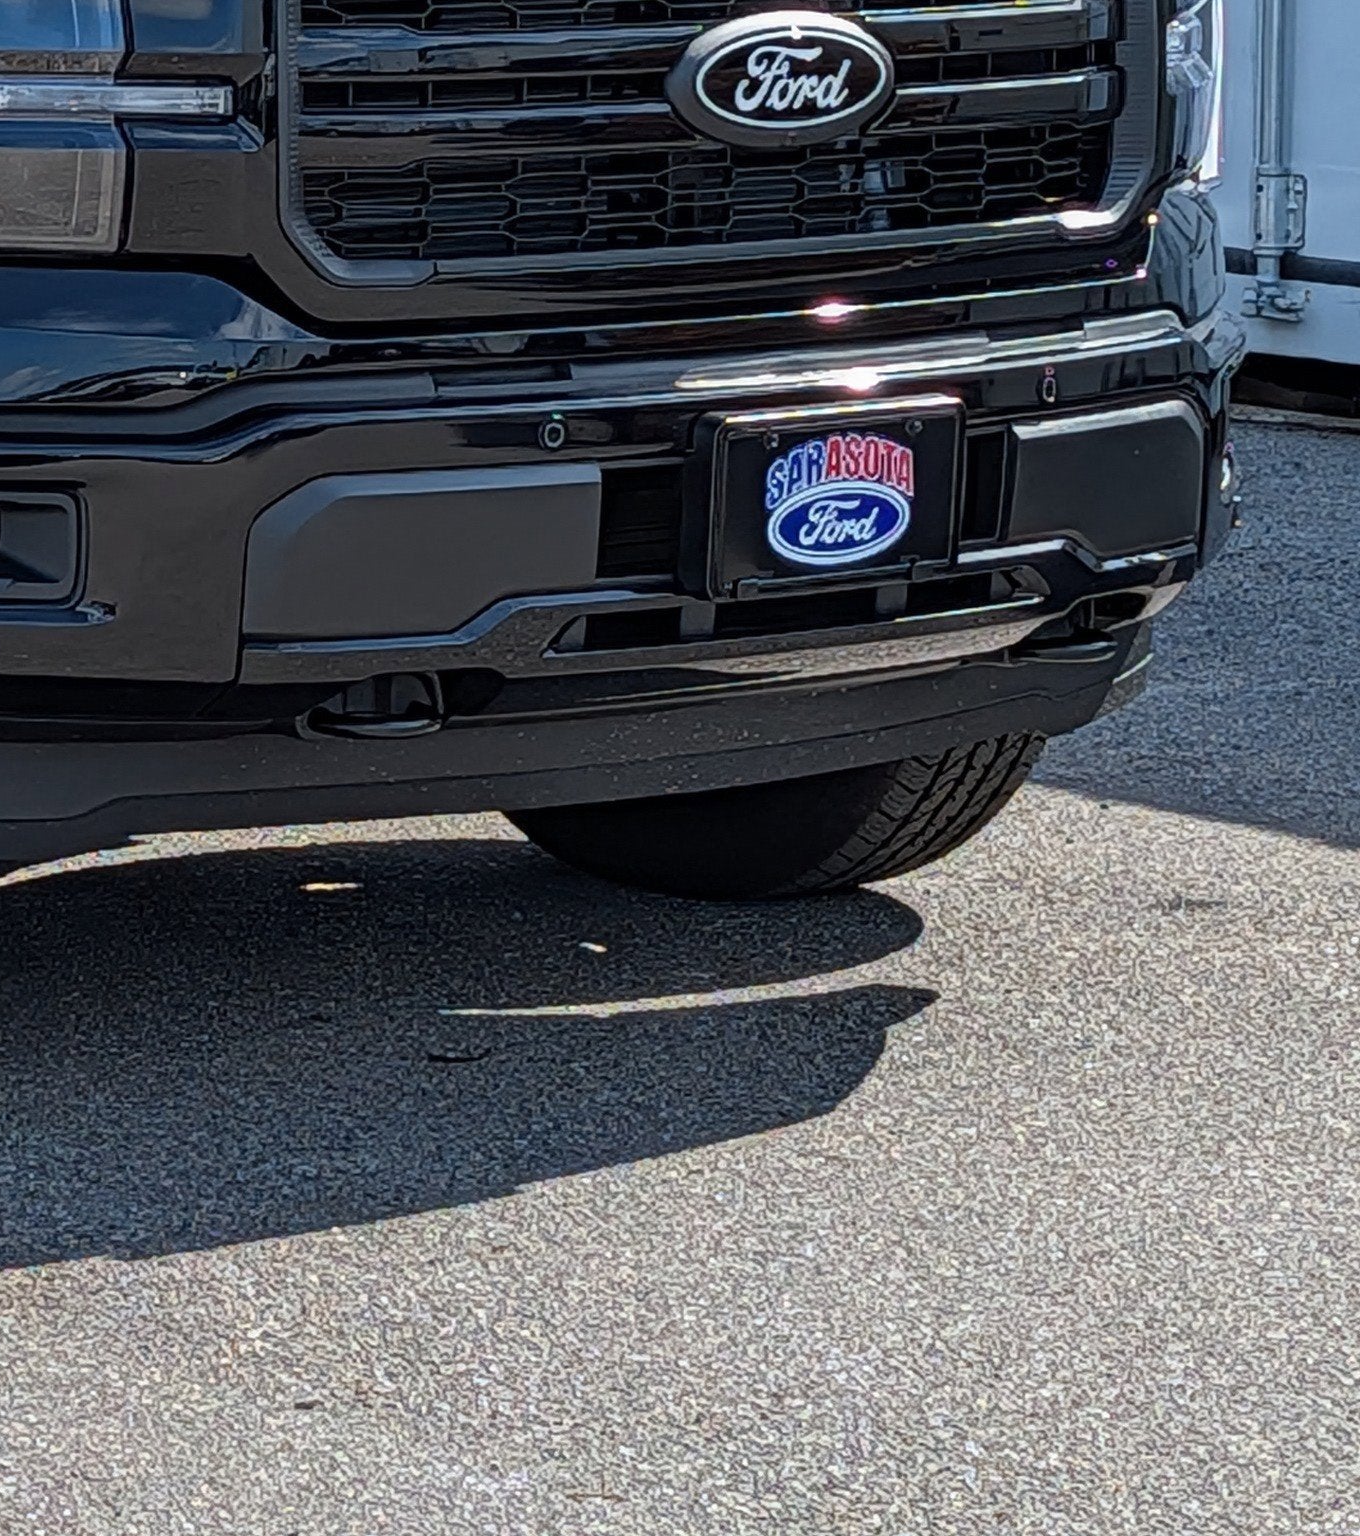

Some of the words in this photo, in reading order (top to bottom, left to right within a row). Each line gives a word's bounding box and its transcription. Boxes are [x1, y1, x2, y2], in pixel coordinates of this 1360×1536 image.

[735, 45, 852, 112] Ford
[765, 434, 914, 511] SARASOTA
[799, 498, 880, 546] Ford
